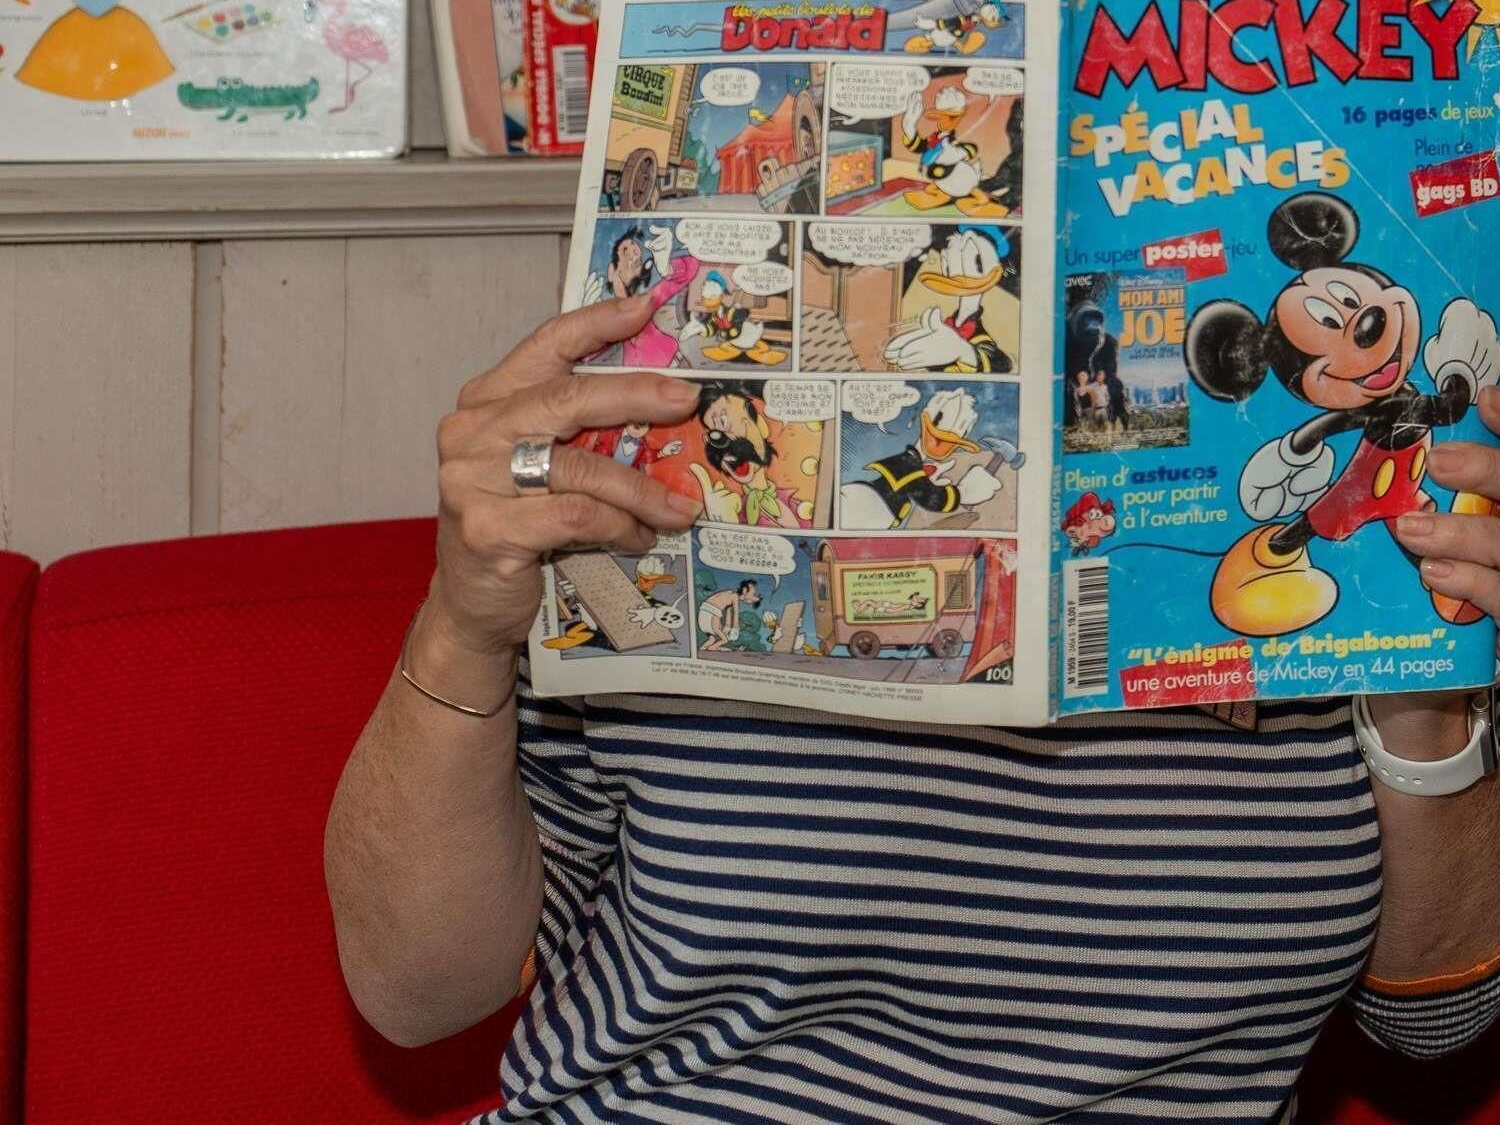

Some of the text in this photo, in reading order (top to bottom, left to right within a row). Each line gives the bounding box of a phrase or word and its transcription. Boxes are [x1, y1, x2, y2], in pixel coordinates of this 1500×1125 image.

[720, 6, 888, 52] Donald
[624, 65, 665, 90] CIRQUE
[1343, 101, 1495, 128] 16 pages de jeux
[1070, 97, 1265, 167] SPÉCIAL
[1414, 138, 1474, 157] Plein de
[1097, 139, 1352, 218] VACANCES
[1416, 177, 1499, 209] gags BD
[1065, 248, 1088, 266] Un
[1093, 246, 1141, 267] super
[1064, 274, 1093, 288] avec
[1119, 288, 1185, 307] MON AMI
[1118, 308, 1185, 348] JOE
[1065, 469, 1107, 491] Plein
[1123, 484, 1220, 510] pour partir
[1123, 505, 1229, 528] à l'aventure
[1261, 636, 1290, 658] de
[986, 667, 1013, 681] 100
[1126, 657, 1455, 693] une aventure de Mickey en 44 pages
